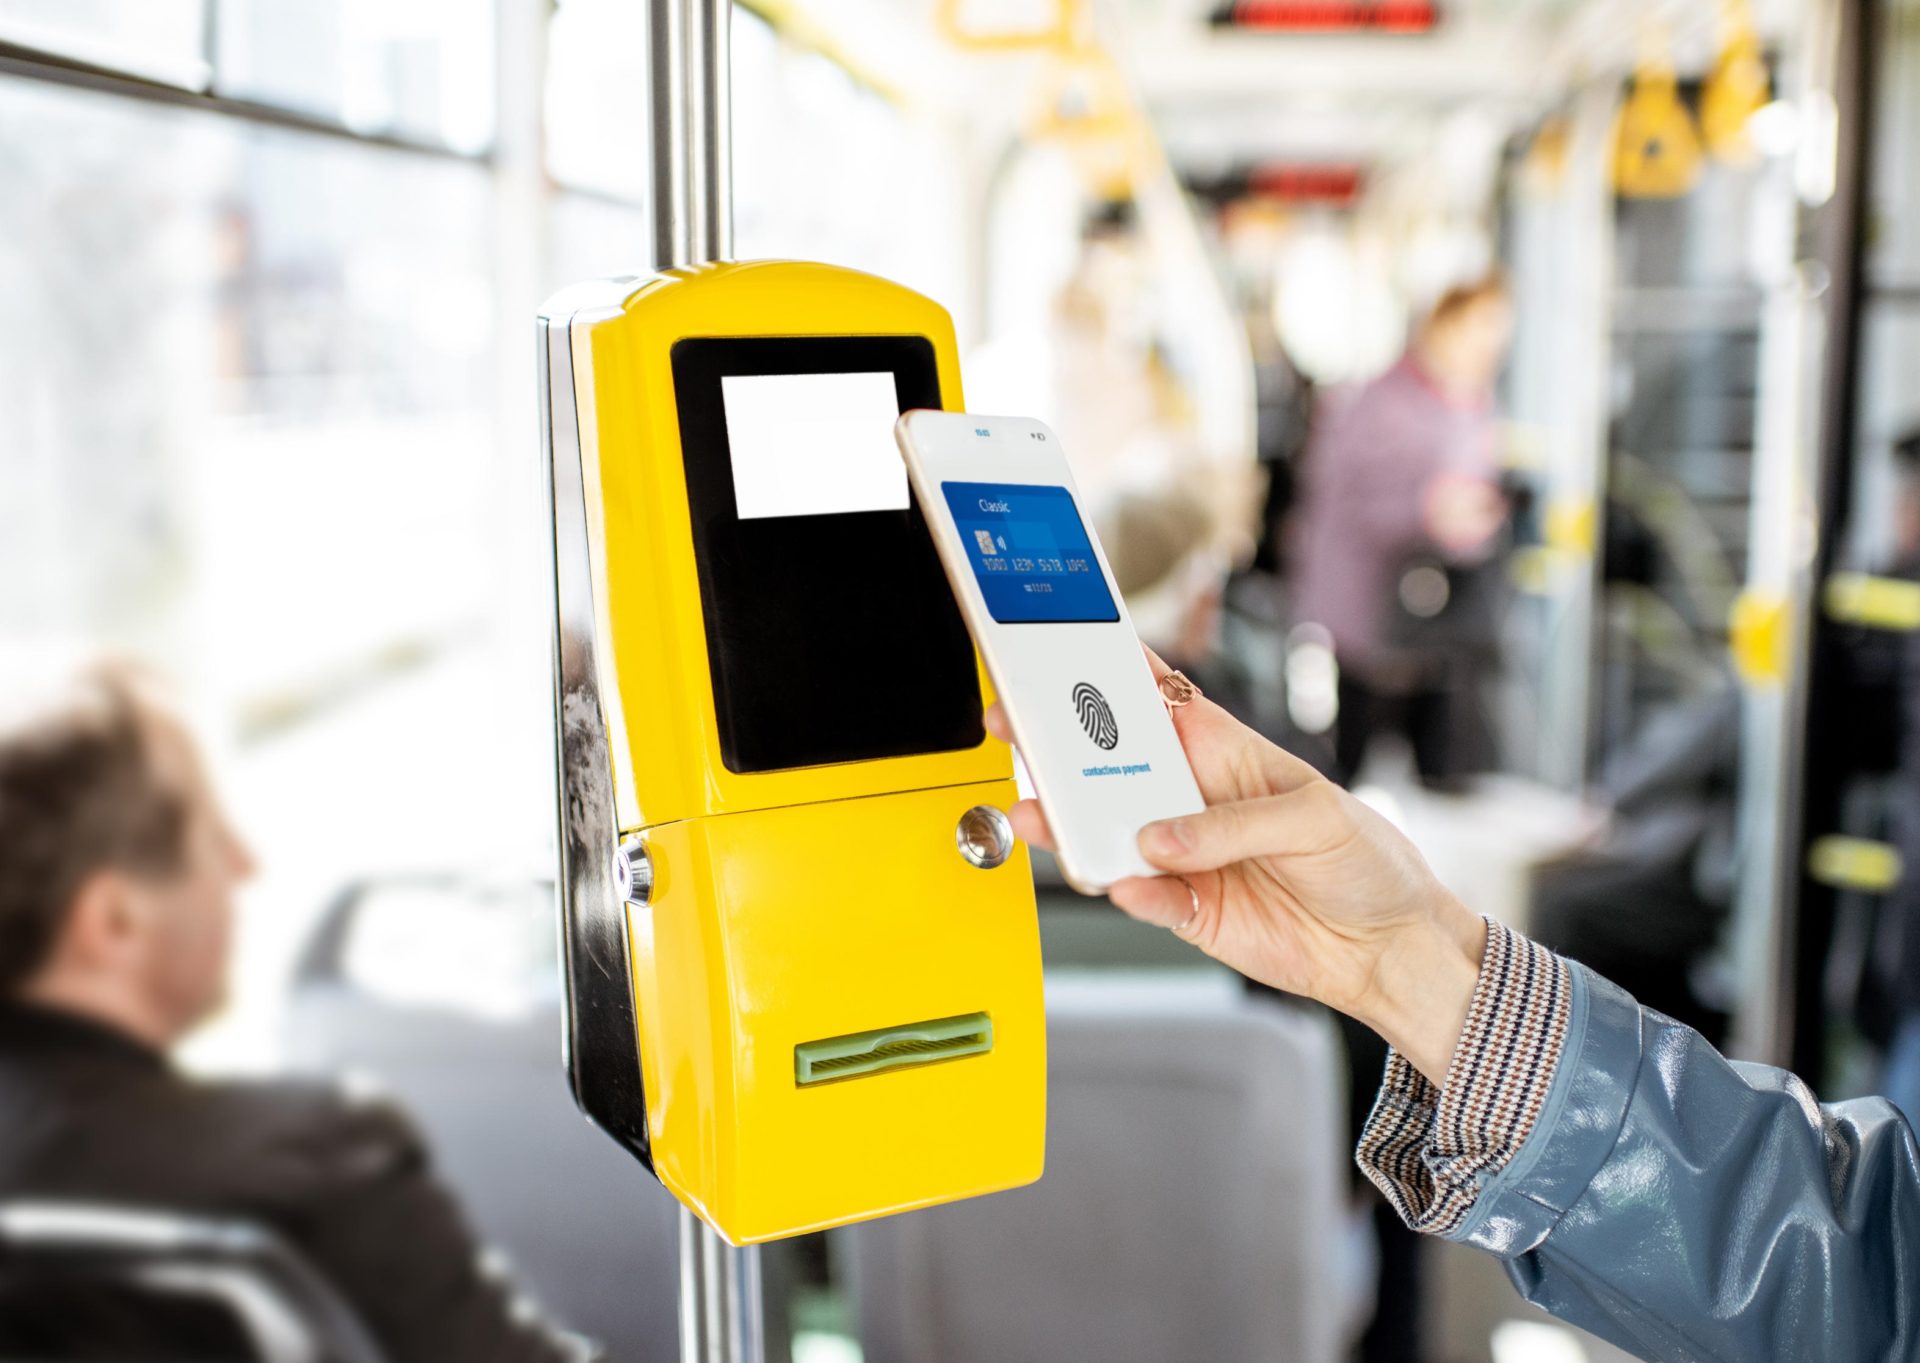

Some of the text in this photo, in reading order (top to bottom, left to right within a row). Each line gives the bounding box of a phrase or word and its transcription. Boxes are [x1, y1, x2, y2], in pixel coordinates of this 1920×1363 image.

[978, 498, 1011, 513] Classic
[1012, 558, 1034, 571] 1234
[1082, 762, 1151, 777] contactless payment
